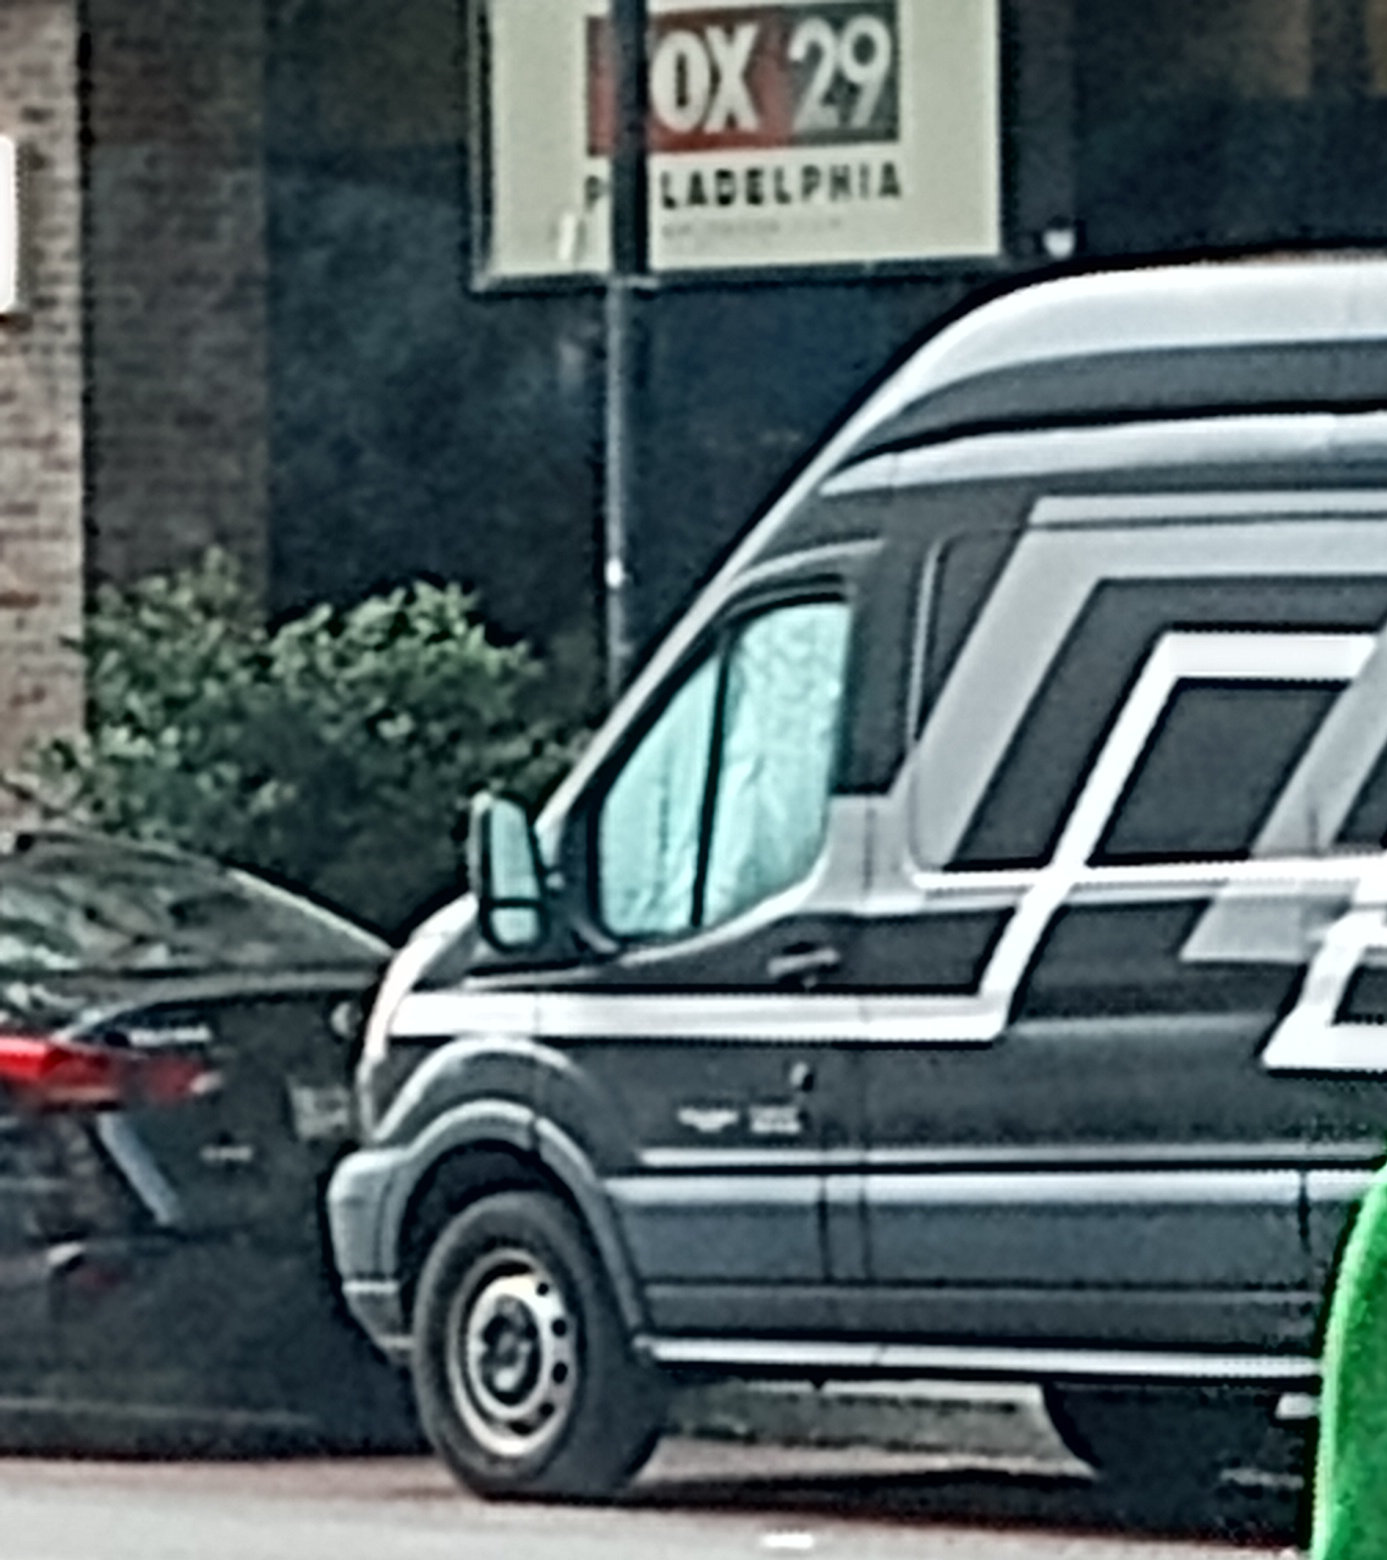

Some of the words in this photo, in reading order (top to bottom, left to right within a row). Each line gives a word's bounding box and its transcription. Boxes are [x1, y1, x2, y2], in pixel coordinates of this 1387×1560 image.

[648, 22, 764, 134] OX
[788, 14, 893, 130] 29
[584, 161, 901, 209] PLADELPHIA
